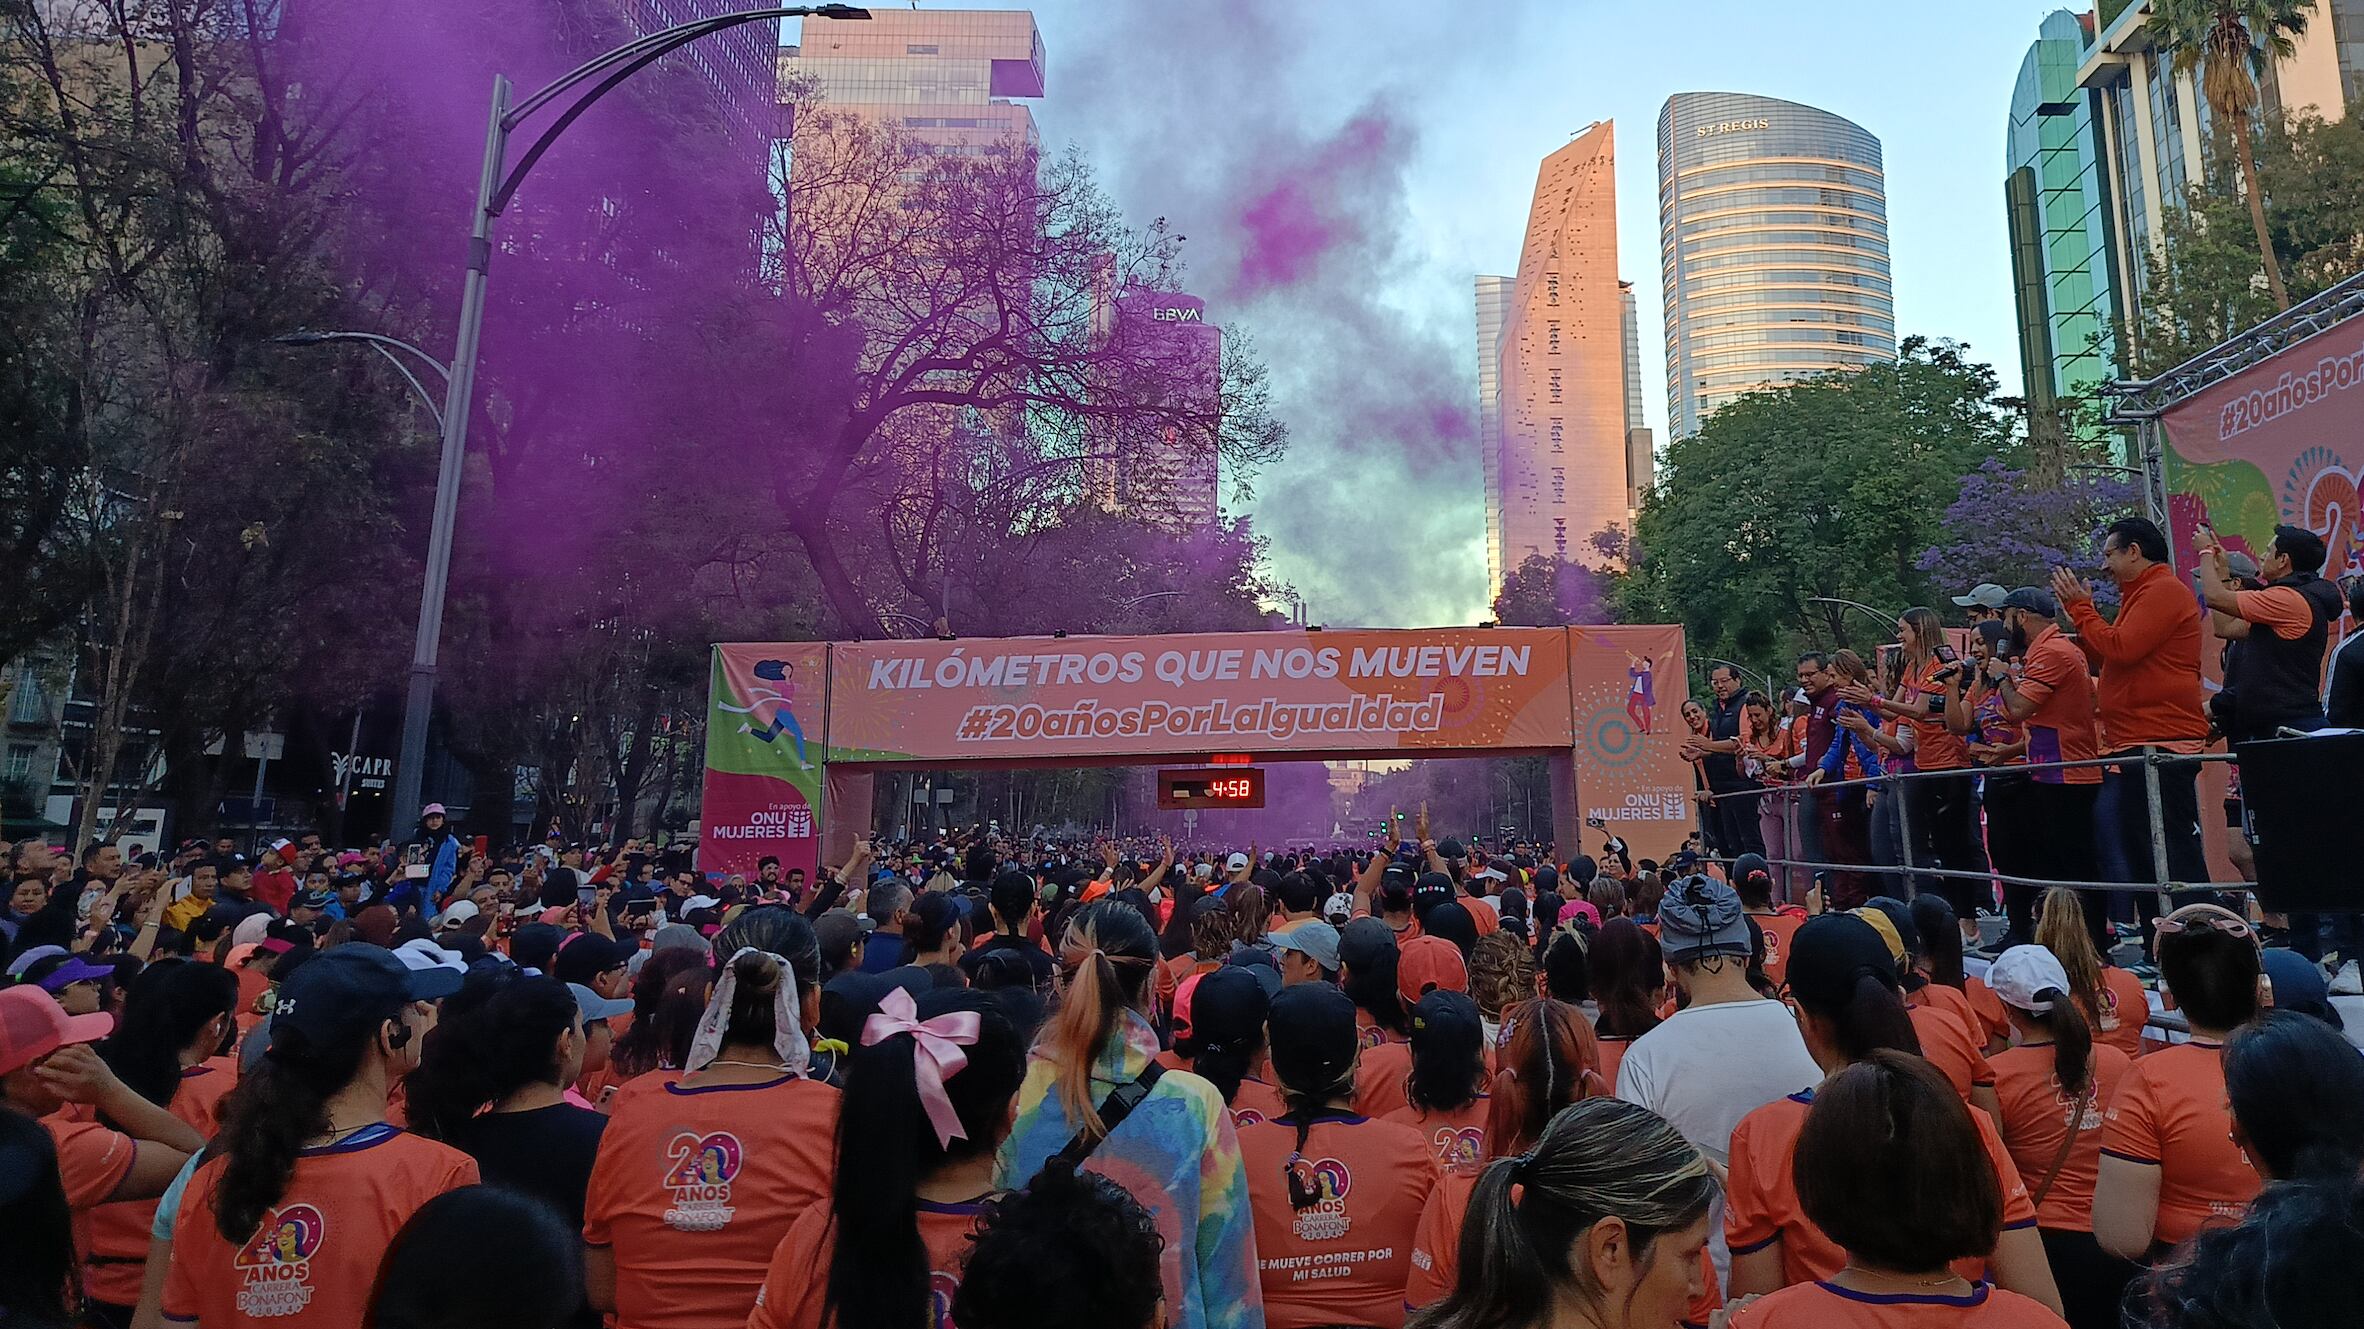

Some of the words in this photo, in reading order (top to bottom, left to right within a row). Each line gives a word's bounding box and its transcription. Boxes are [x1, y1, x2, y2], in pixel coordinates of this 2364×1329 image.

[1720, 118, 1769, 134] REGIS
[1153, 307, 1201, 322] BBVA
[867, 647, 1147, 690] KILÓMETROS
[1153, 649, 1244, 688] QUE
[1249, 647, 1342, 680] NOS
[1348, 645, 1532, 679] MUEVEN
[779, 804, 801, 812] apoyo
[1625, 794, 1660, 807] ONU
[751, 812, 786, 825] ONU
[1589, 807, 1661, 820] MUJERES
[713, 826, 786, 839] MUJERES
[1294, 1218, 1350, 1233] BONAFONT
[1303, 1214, 1340, 1223] CARRERA
[1268, 1256, 1311, 1270] MUEVE
[1313, 1251, 1365, 1265] CORRER
[1368, 1247, 1393, 1261] POR
[1293, 1270, 1309, 1281] MI
[1311, 1266, 1352, 1279] SALUD
[238, 1285, 314, 1309] BONAFONT
